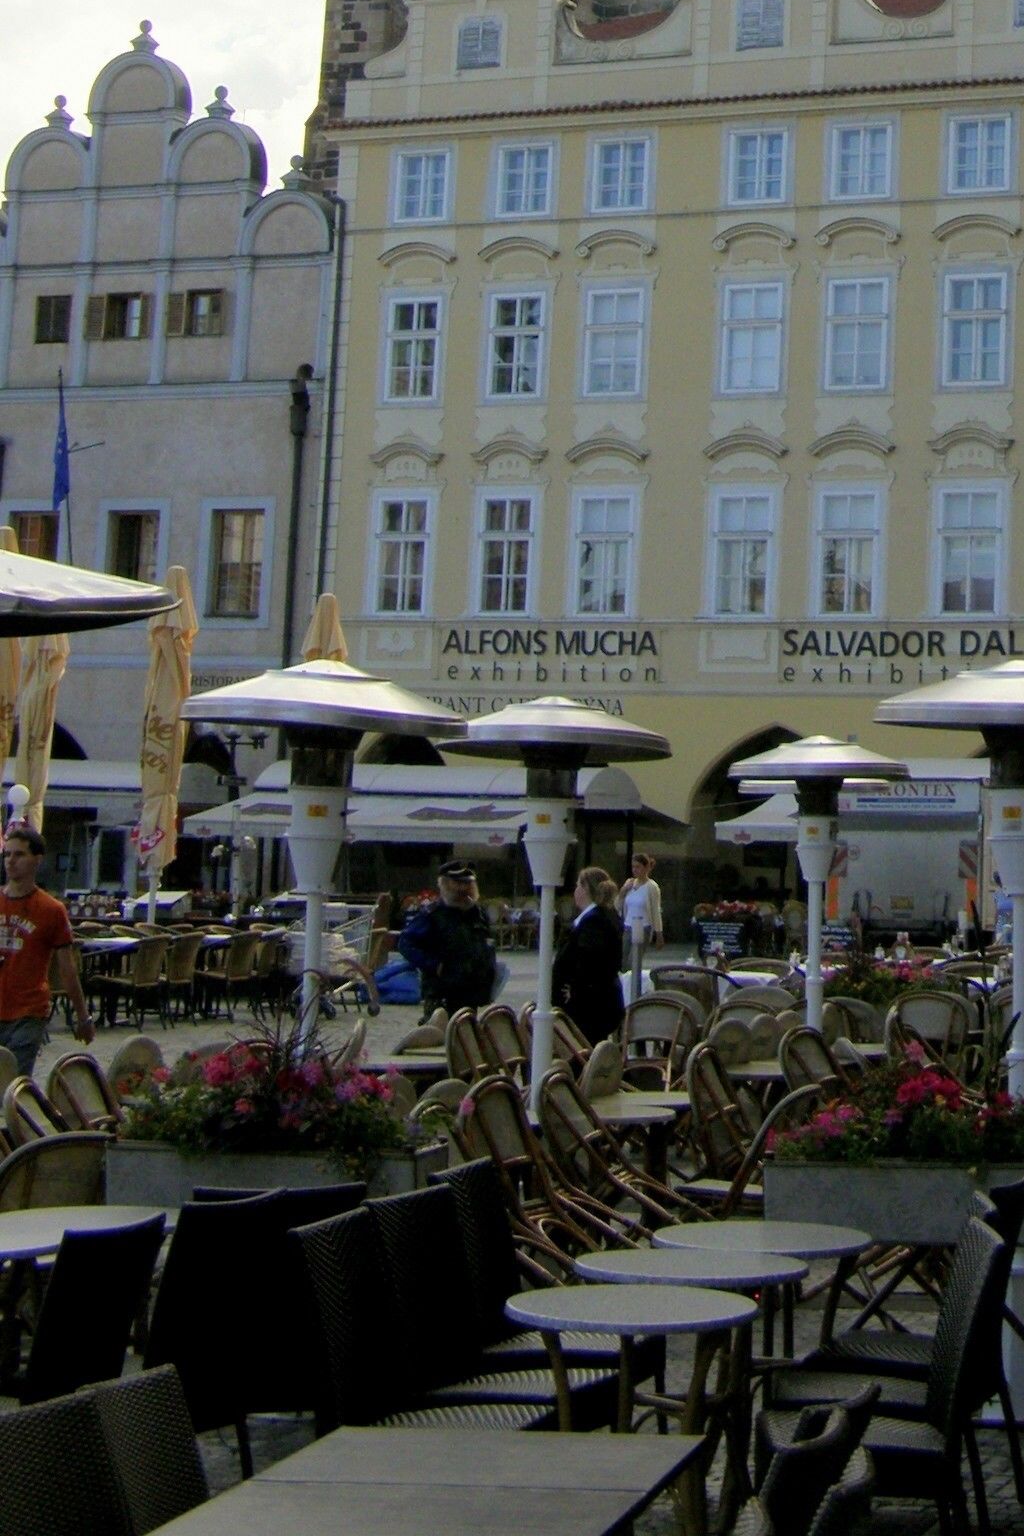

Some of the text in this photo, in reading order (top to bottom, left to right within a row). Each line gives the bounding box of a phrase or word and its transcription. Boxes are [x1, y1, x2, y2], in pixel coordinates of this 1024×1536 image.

[443, 629, 658, 656] ALFONS MUCHA
[783, 628, 946, 657] SALVADOR
[447, 662, 656, 682] exhibition
